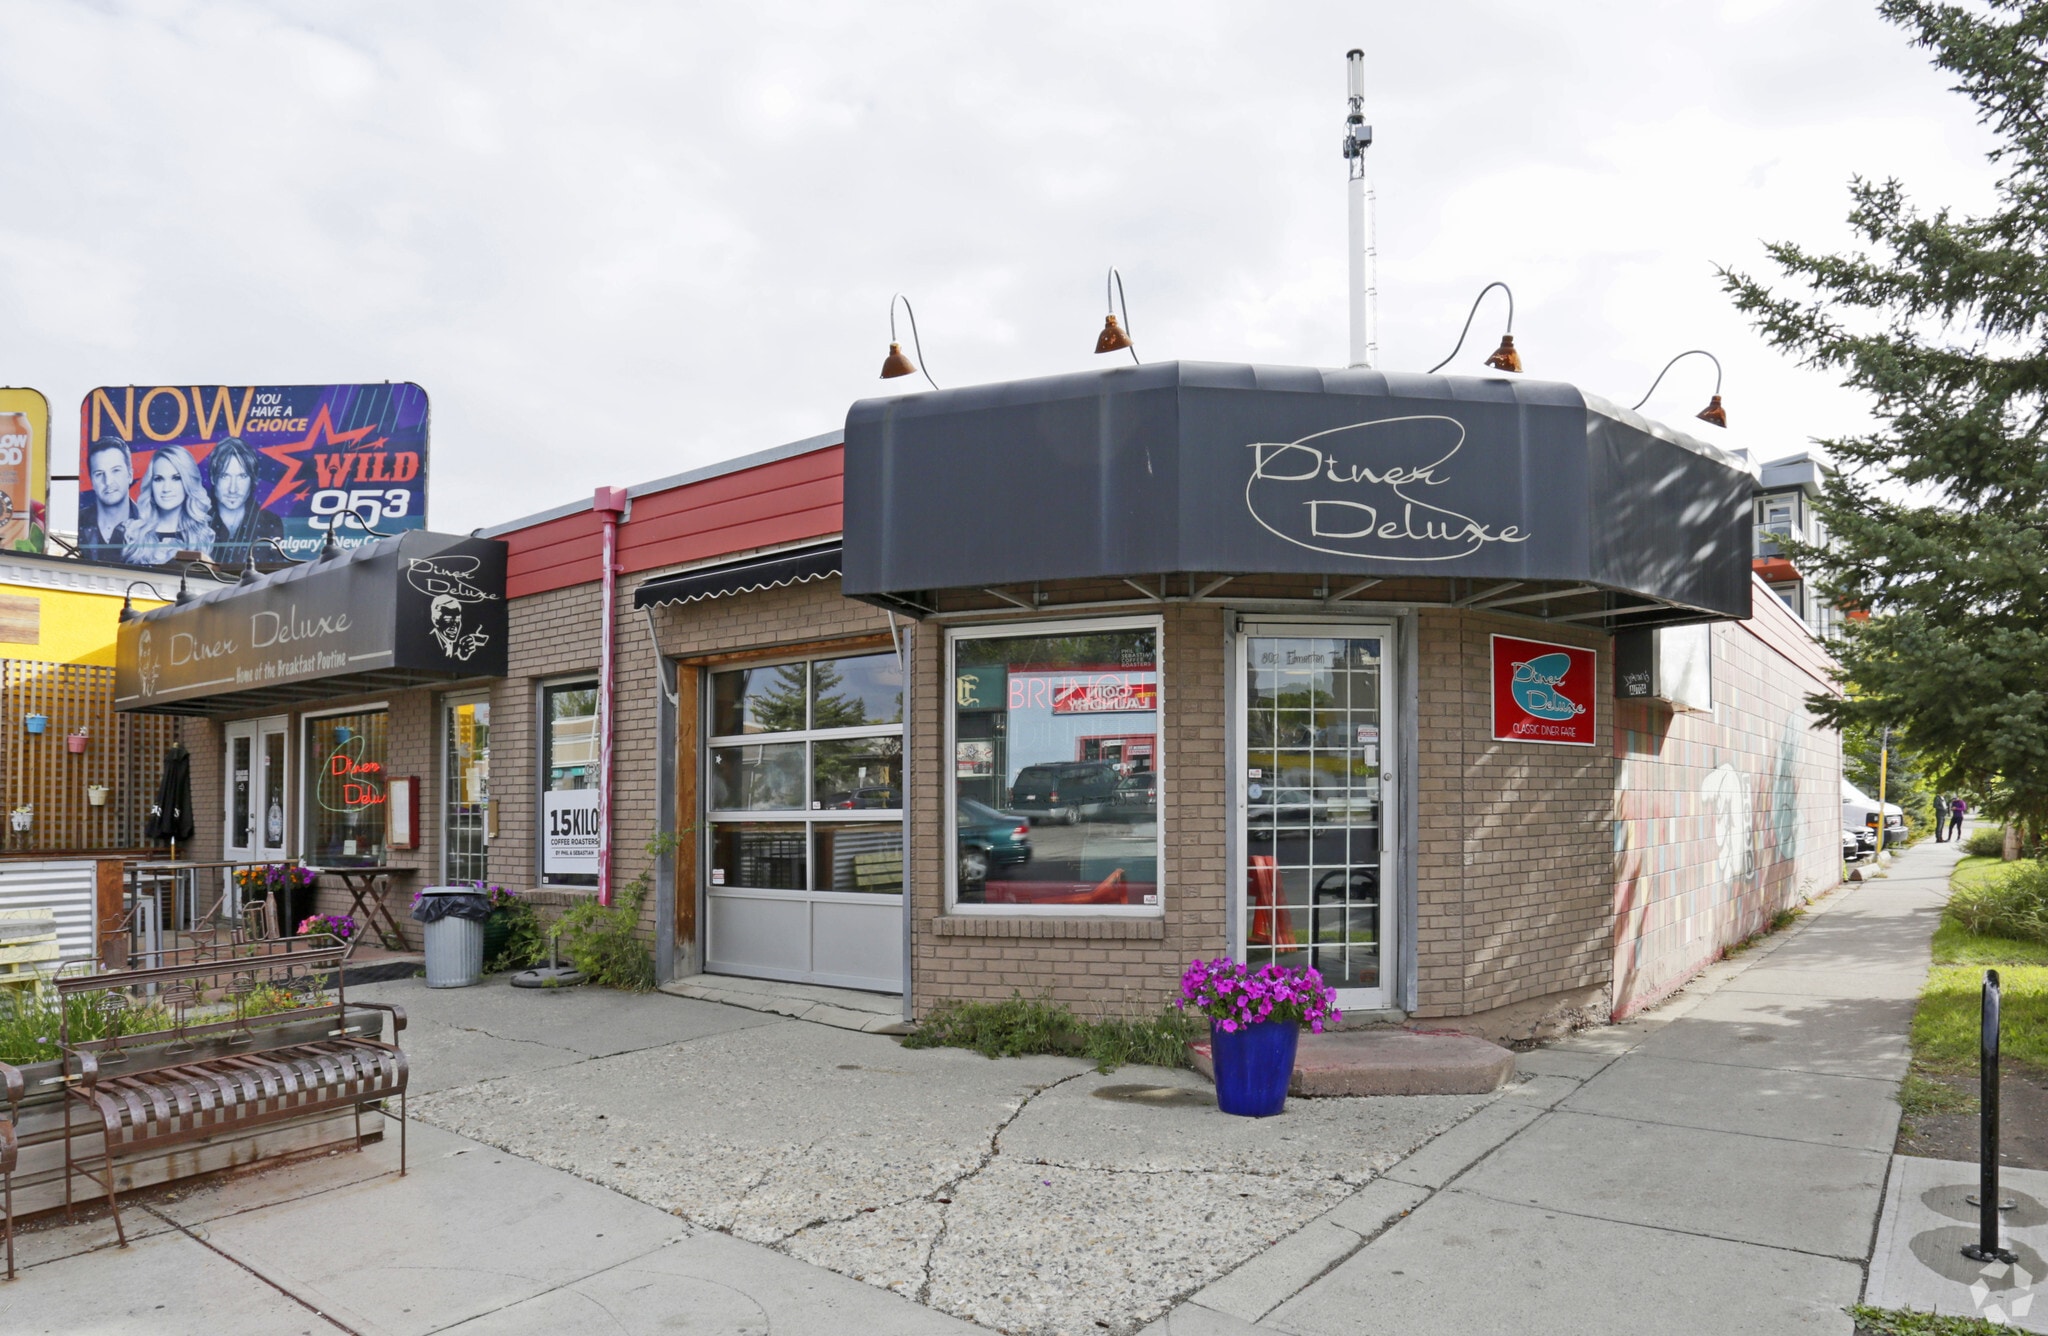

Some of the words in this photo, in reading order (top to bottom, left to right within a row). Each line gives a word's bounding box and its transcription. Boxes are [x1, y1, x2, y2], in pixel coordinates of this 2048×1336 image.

[255, 393, 281, 405] YOU
[92, 386, 255, 442] NOW
[250, 405, 282, 417] HAVE
[283, 406, 292, 417] A
[246, 418, 308, 432] CHOICE
[314, 451, 420, 488] WILD
[1246, 442, 1450, 485] Diner
[1302, 499, 1531, 543] Deluxe
[408, 557, 475, 579] Diner
[426, 578, 500, 601] Deluxe
[169, 632, 239, 666] Diner
[250, 603, 353, 649] Deluxe
[236, 666, 253, 684] Home
[254, 662, 263, 681] of
[264, 661, 276, 679] the
[277, 654, 316, 678] Breakfast
[317, 650, 347, 671] Poutine
[1511, 662, 1565, 687] Diner
[1008, 673, 1146, 710] BRUNCH
[1526, 690, 1587, 714] Deluxe
[1512, 723, 1540, 734] CLASSIC
[1541, 725, 1559, 736] DINER
[1560, 727, 1576, 737] FARE
[331, 754, 381, 776] Diner
[342, 783, 387, 805] Delu
[551, 838, 570, 846] COFFEE
